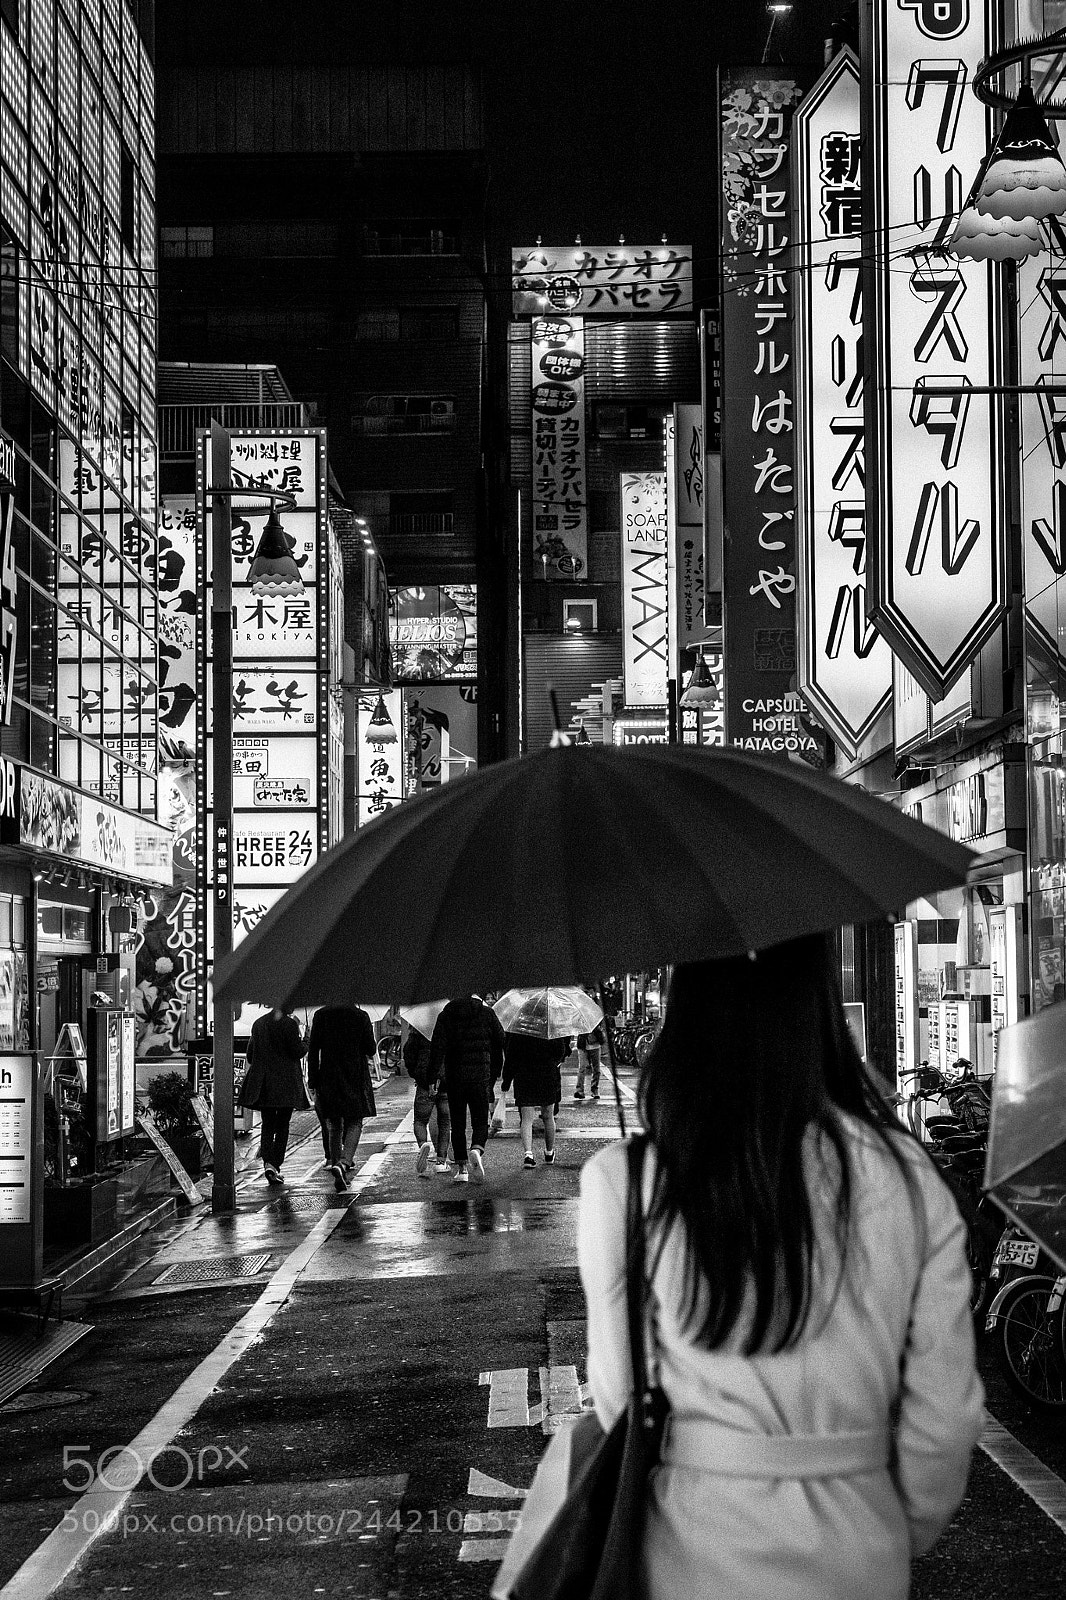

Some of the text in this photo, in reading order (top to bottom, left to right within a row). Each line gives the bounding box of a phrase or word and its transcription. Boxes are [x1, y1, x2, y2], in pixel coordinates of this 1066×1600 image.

[754, 106, 790, 375] カプセルホテル
[575, 250, 691, 280] カラオケ
[587, 282, 683, 308] パセラ
[550, 366, 574, 375] OK
[231, 440, 302, 462] 州料理
[560, 417, 582, 530] カラオケパセラ
[750, 390, 797, 610] はたごや
[626, 529, 667, 542] LAND
[231, 598, 314, 630] 木屋
[629, 548, 667, 664] MAX
[432, 616, 458, 624] STUDIO
[742, 698, 807, 713] CAPSULE
[752, 717, 799, 732] HOTEL
[734, 737, 819, 752] HATAGOYA
[236, 837, 286, 852] HREE
[217, 827, 228, 900] 仲見世通り
[1005, 1250, 1036, 1265] 53-15
